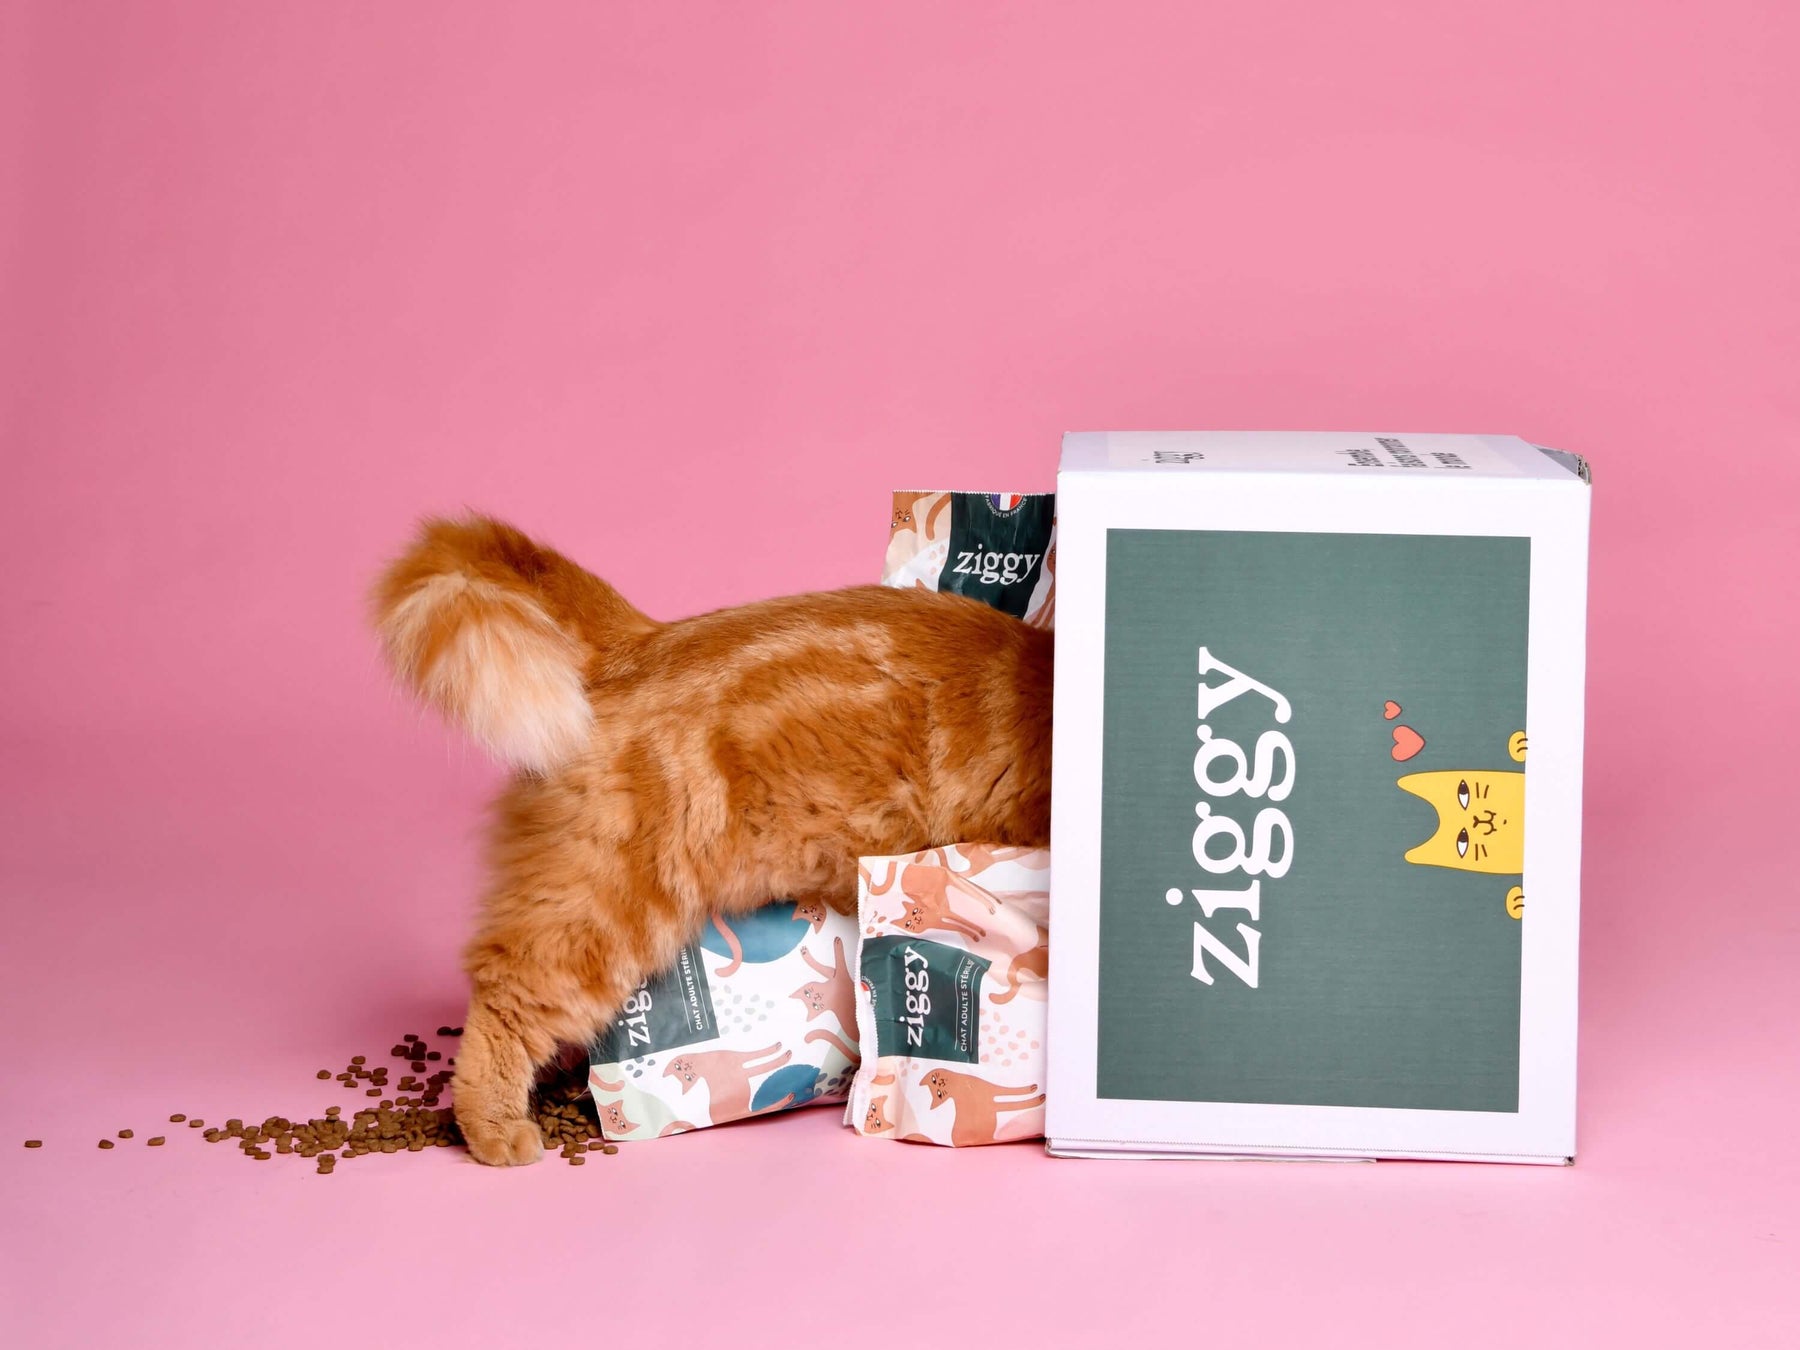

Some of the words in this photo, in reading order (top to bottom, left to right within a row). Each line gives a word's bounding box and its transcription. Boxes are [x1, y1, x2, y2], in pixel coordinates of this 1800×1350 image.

[952, 543, 1041, 586] ziggy
[1165, 646, 1297, 989] ziggy
[685, 976, 699, 1008] ADULTE
[899, 945, 931, 1048] ziggy
[961, 991, 969, 1026] ADULTE
[617, 976, 653, 1048] zig
[692, 1009, 704, 1031] CHAT
[960, 1028, 968, 1052] CHAT
